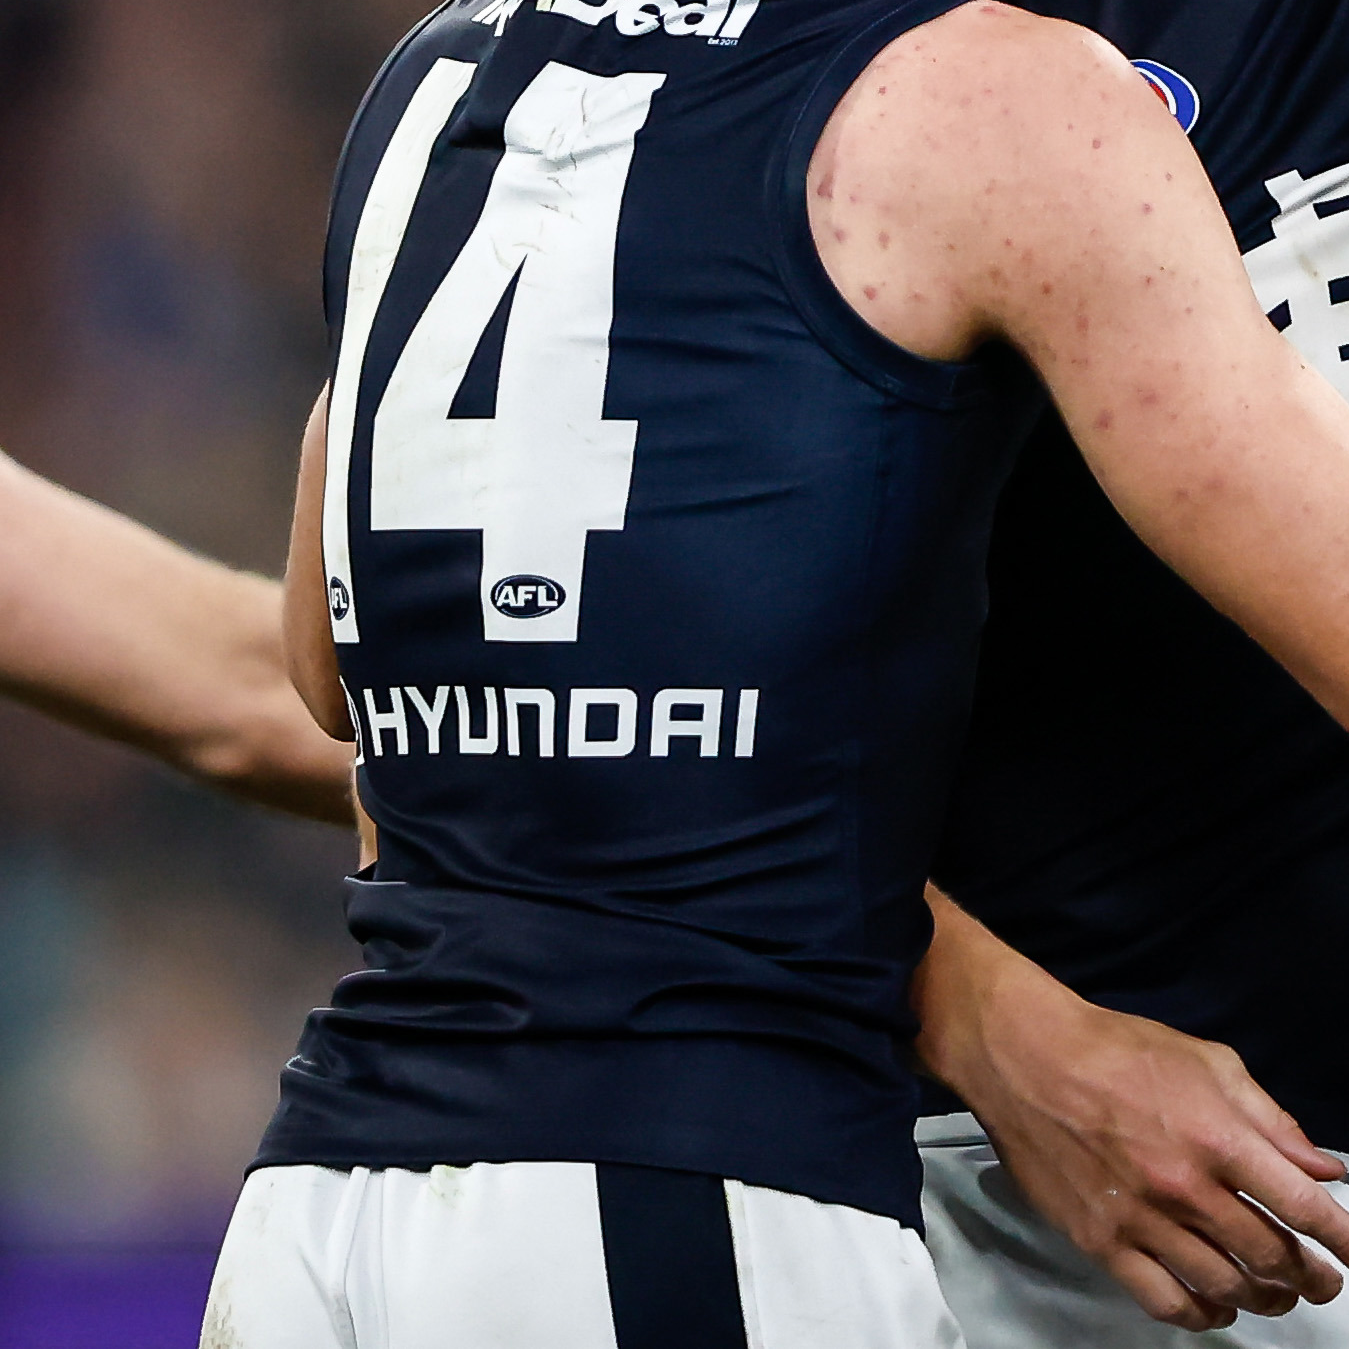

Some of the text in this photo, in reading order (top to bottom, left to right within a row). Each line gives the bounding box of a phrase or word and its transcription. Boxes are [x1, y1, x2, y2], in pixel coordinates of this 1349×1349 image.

[322, 57, 668, 644] 14
[496, 585, 558, 607] AFL
[362, 685, 760, 758] HYUNDAI
